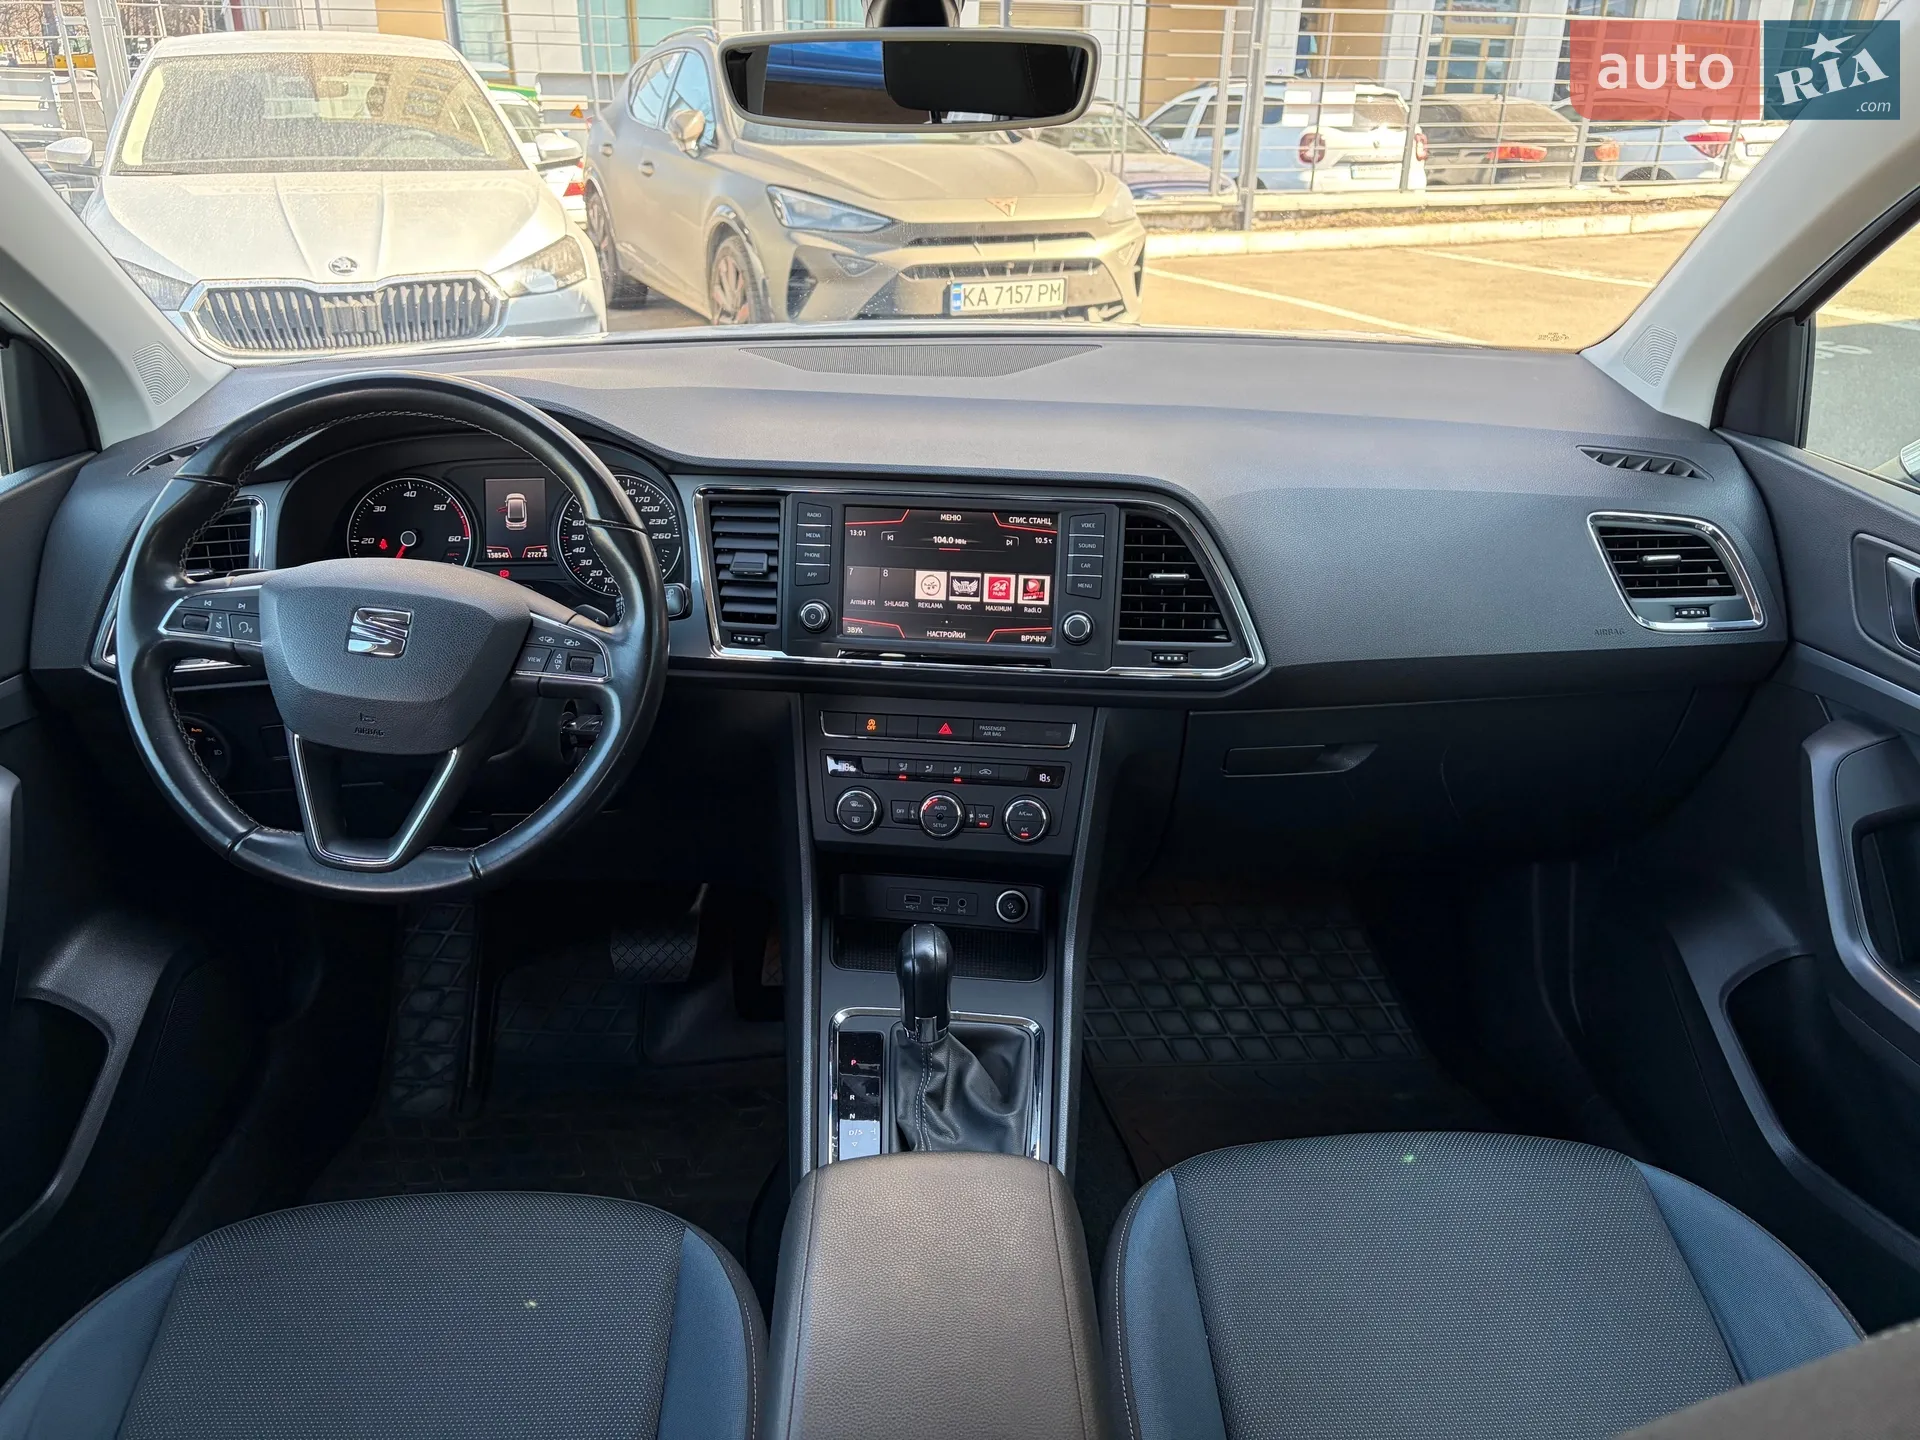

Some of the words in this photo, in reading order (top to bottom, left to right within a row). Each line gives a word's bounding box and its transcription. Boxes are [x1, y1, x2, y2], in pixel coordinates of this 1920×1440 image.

[963, 287, 989, 307] KA
[995, 285, 1033, 306] 7157
[1038, 282, 1061, 303] PM
[403, 490, 417, 498] 40
[373, 505, 387, 513] 30
[433, 503, 447, 511] 50
[640, 505, 660, 513] 200
[940, 513, 962, 521] МЕНЮ
[648, 518, 668, 526] 230
[652, 532, 671, 540] 260
[849, 529, 866, 537] 13:01
[361, 537, 375, 545] 20
[448, 535, 461, 543] 60
[571, 534, 585, 542] 50
[932, 535, 954, 545] 104.0
[1034, 536, 1048, 544] 10.5
[590, 569, 603, 577] 20
[848, 567, 854, 576] 7
[882, 569, 889, 578] 8
[993, 583, 1007, 592] 24
[884, 600, 909, 608] SHLAGER
[956, 603, 972, 611] ROKS
[985, 605, 1012, 613] MAXIMUM
[846, 626, 863, 634] ЗВУК
[1594, 628, 1625, 636] AIRBAG
[926, 630, 966, 639] НАСТРОЙКИ
[1020, 635, 1046, 643] ВРУЧНУ
